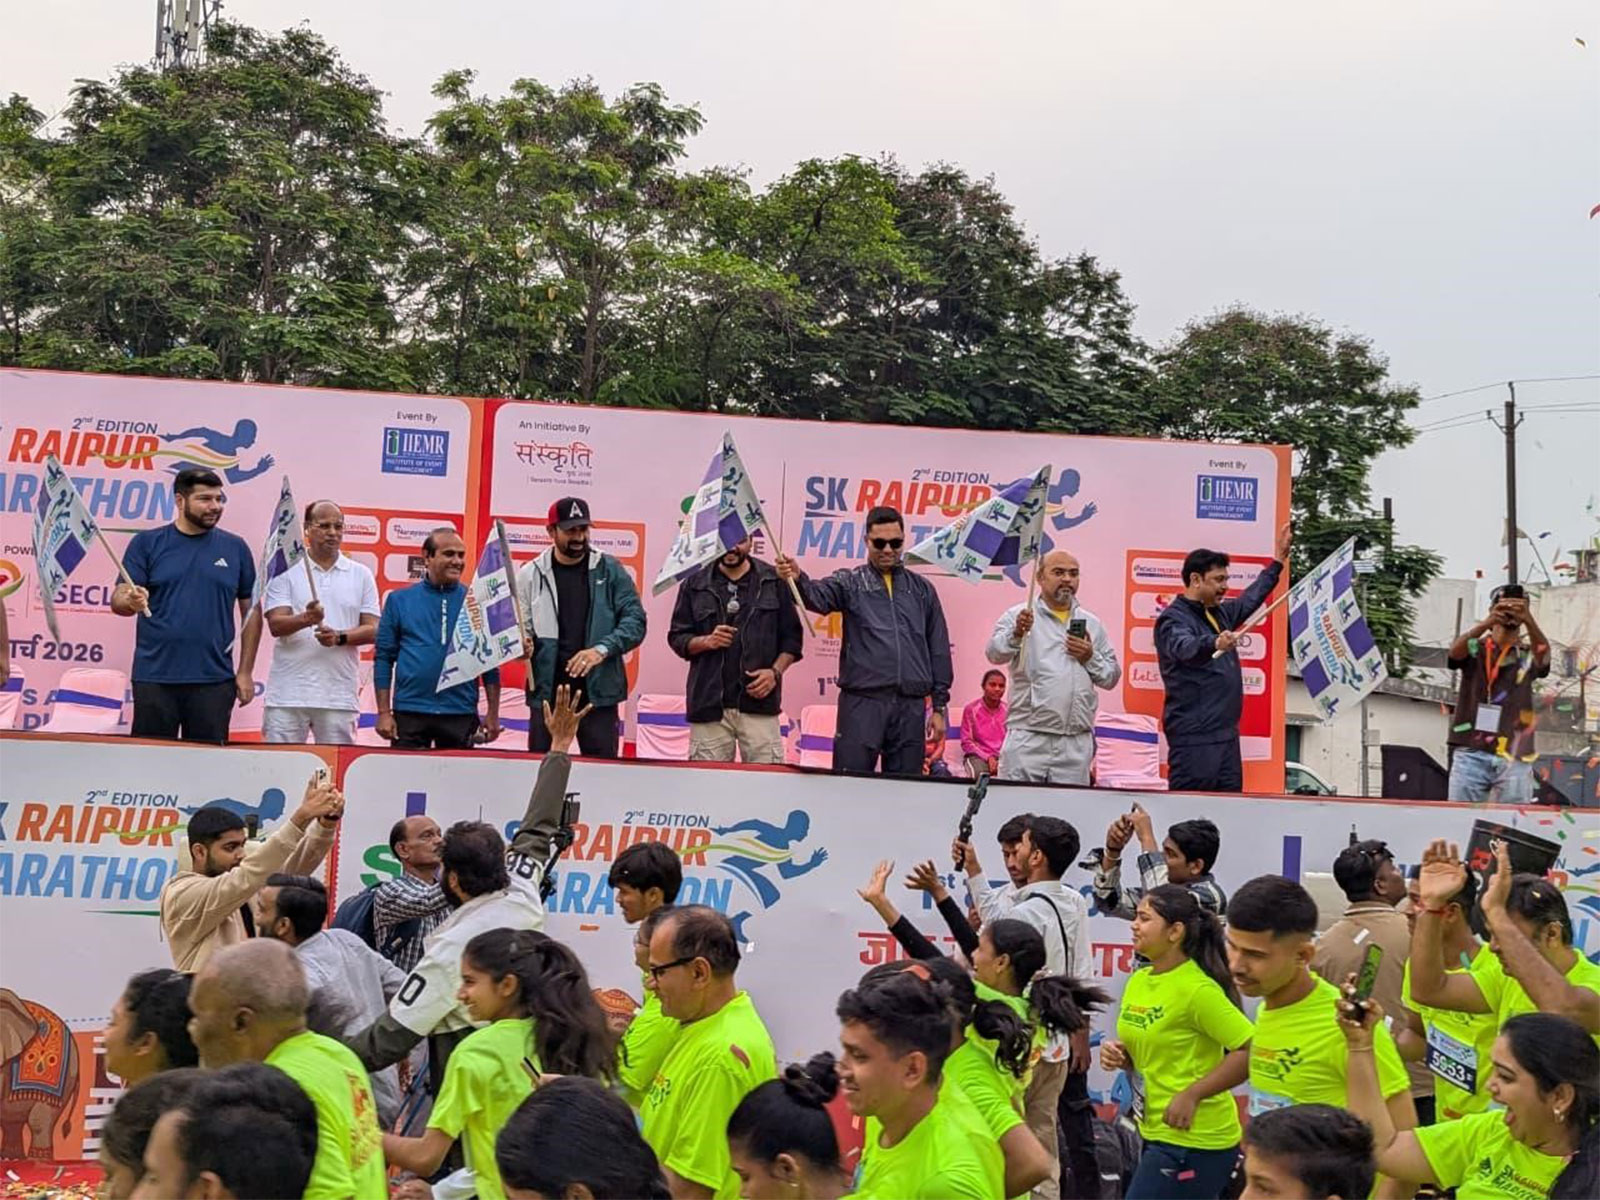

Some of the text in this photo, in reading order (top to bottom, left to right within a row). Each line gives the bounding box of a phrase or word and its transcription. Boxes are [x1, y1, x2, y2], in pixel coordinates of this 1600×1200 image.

[72, 417, 158, 434] 2nd EDITION
[397, 411, 438, 423] Event By
[519, 421, 591, 434] An Initiative By
[8, 428, 160, 470] RAIPUR
[1209, 459, 1247, 471] Event By
[912, 469, 990, 484] 2nd EDITION
[805, 476, 849, 512] SK
[569, 502, 583, 519] A
[54, 584, 112, 606] SECL
[42, 641, 104, 662] 2026
[85, 790, 179, 808] 2nd EDITION
[16, 803, 180, 847] RAIPUR
[624, 810, 710, 828] 2nd EDITION
